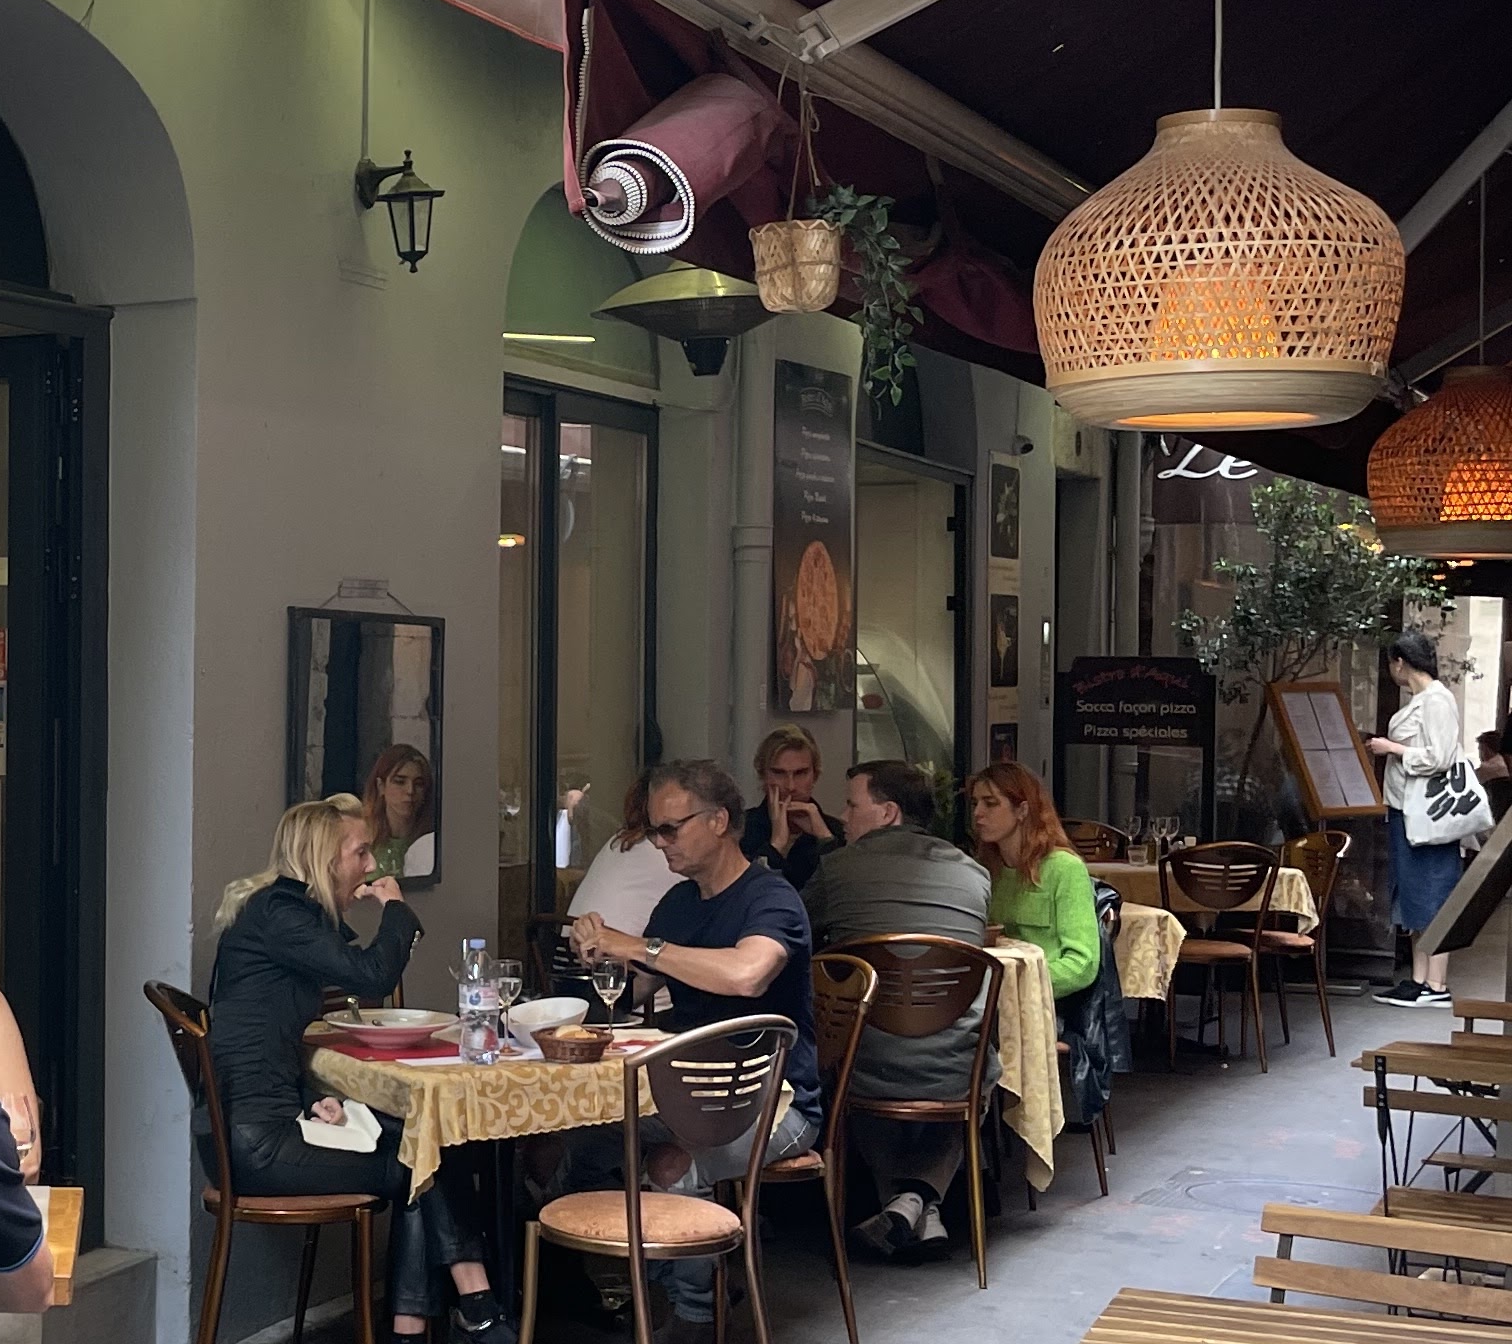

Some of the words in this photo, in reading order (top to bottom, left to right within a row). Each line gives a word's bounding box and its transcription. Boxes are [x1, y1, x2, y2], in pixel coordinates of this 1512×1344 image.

[1076, 699, 1116, 713] Socca
[1118, 700, 1157, 716] façon
[1159, 702, 1197, 717] pizza
[1083, 723, 1119, 737] Pizza
[1122, 724, 1188, 740] spéciales
